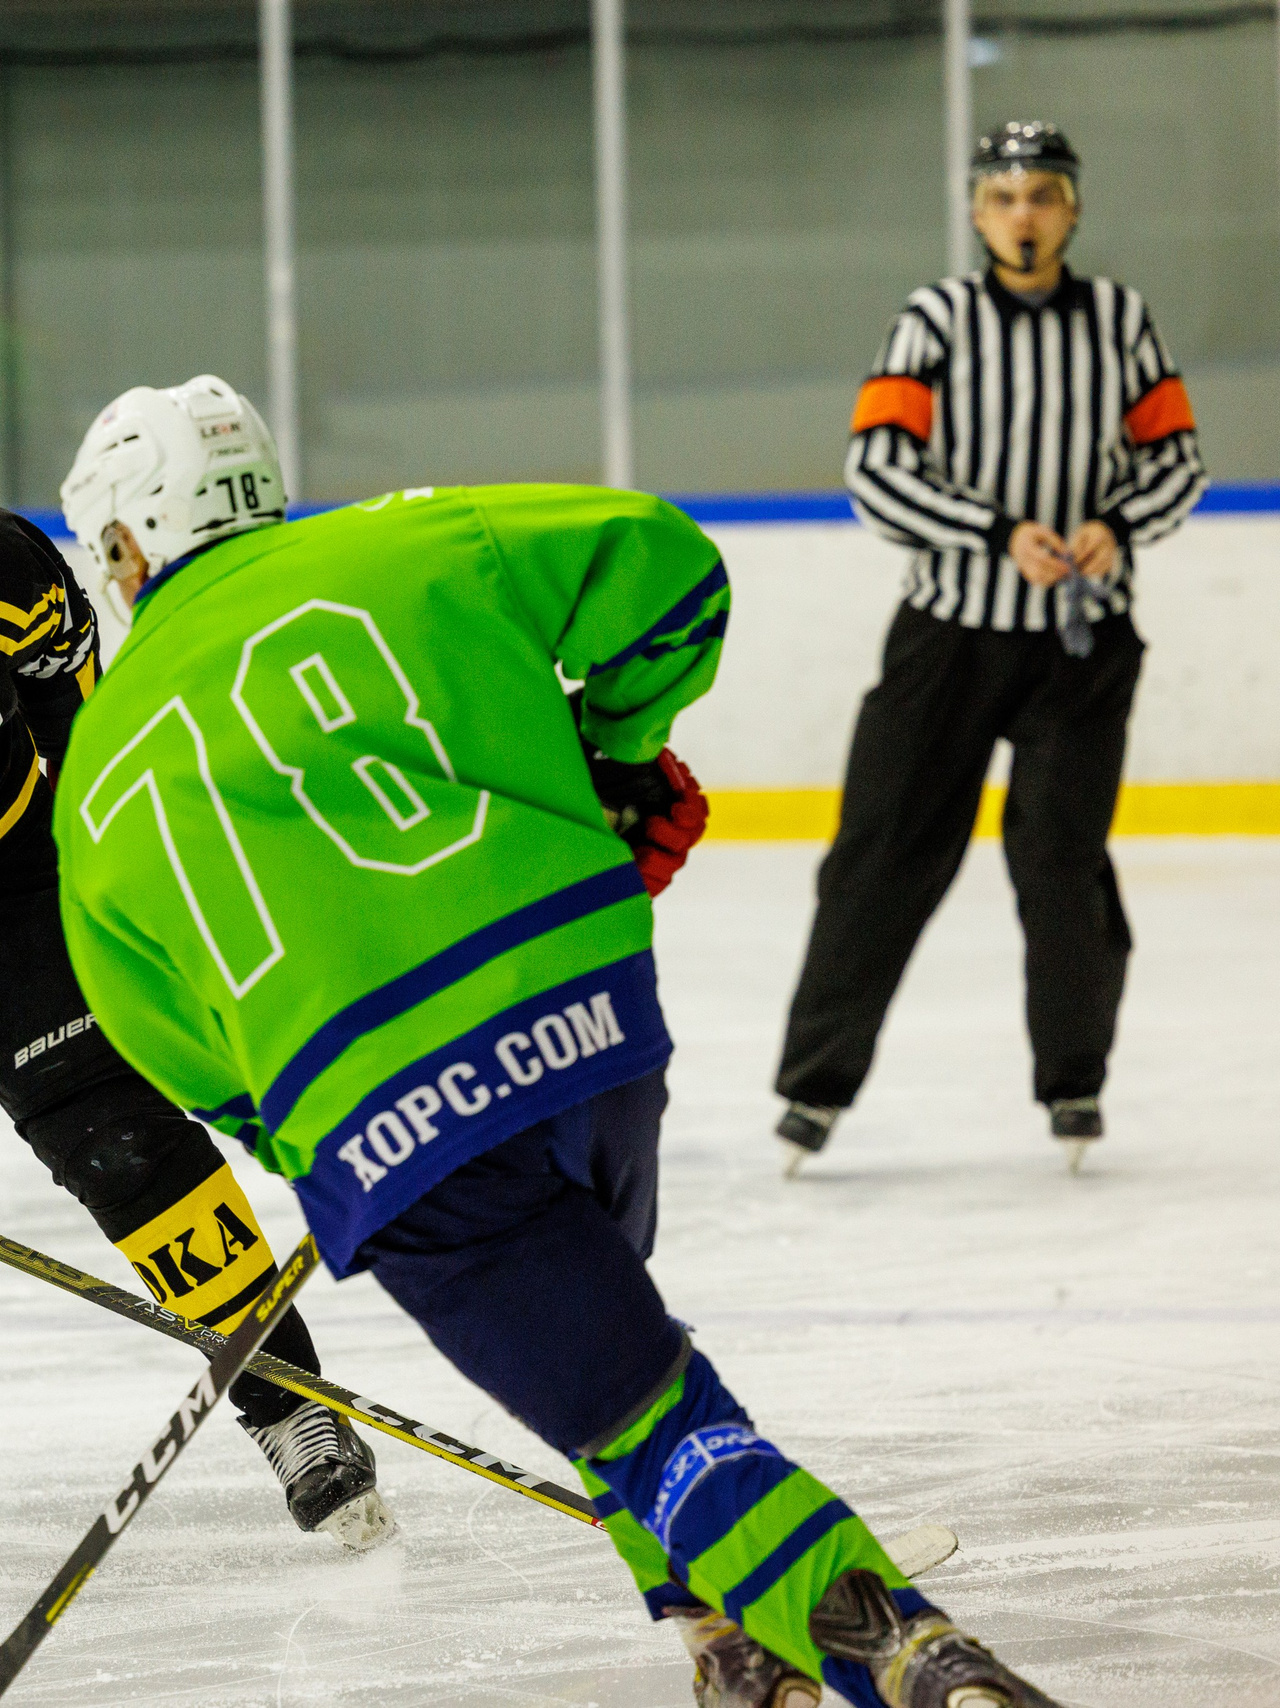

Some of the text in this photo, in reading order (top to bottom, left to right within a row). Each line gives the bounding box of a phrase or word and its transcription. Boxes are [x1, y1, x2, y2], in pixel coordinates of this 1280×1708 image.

[215, 472, 259, 513] 78
[80, 599, 490, 999] 78
[255, 1254, 305, 1323] SUPER
[103, 1367, 218, 1535] CCM
[350, 1396, 549, 1489] CCM
